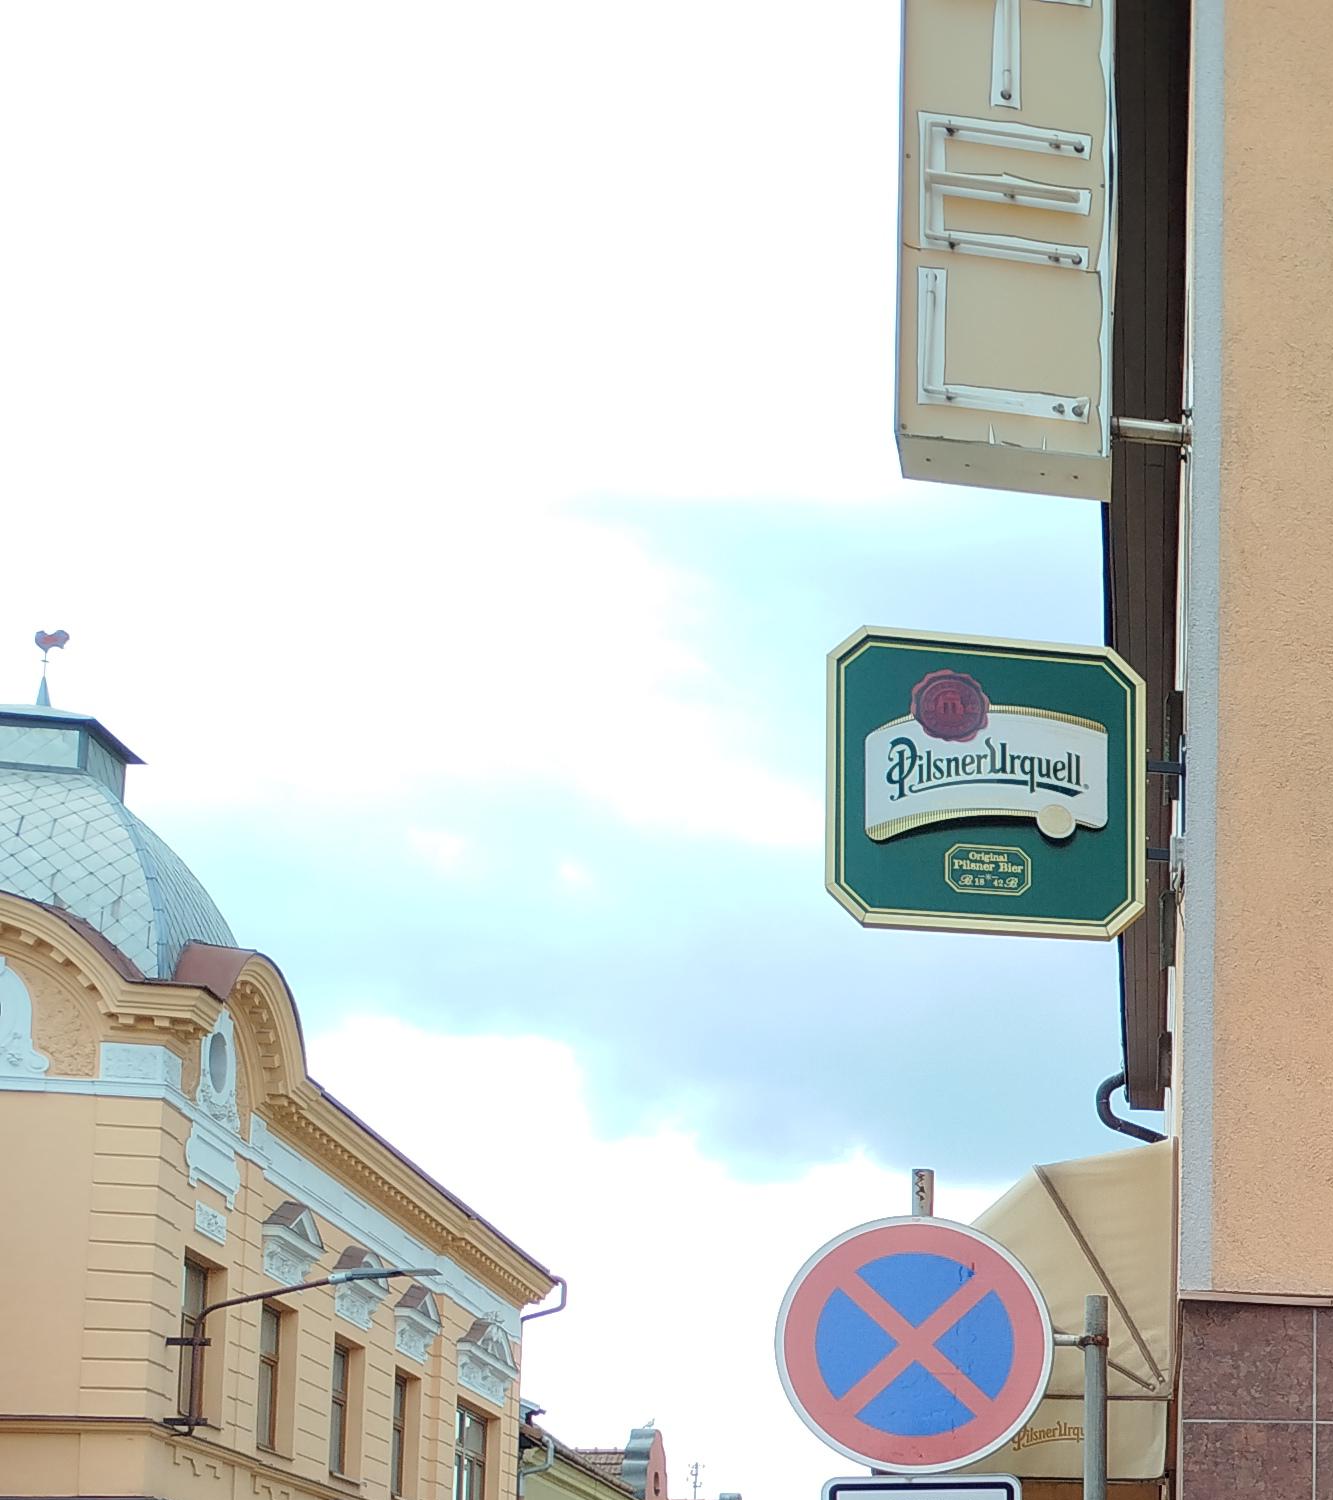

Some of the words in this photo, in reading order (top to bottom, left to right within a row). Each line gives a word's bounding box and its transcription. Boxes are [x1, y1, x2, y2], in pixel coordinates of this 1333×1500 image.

[886, 736, 988, 801] Pilsner
[985, 736, 1081, 793] Urquell
[968, 851, 1008, 862] Original
[953, 859, 995, 871] Pilsner
[998, 862, 1024, 873] Bier
